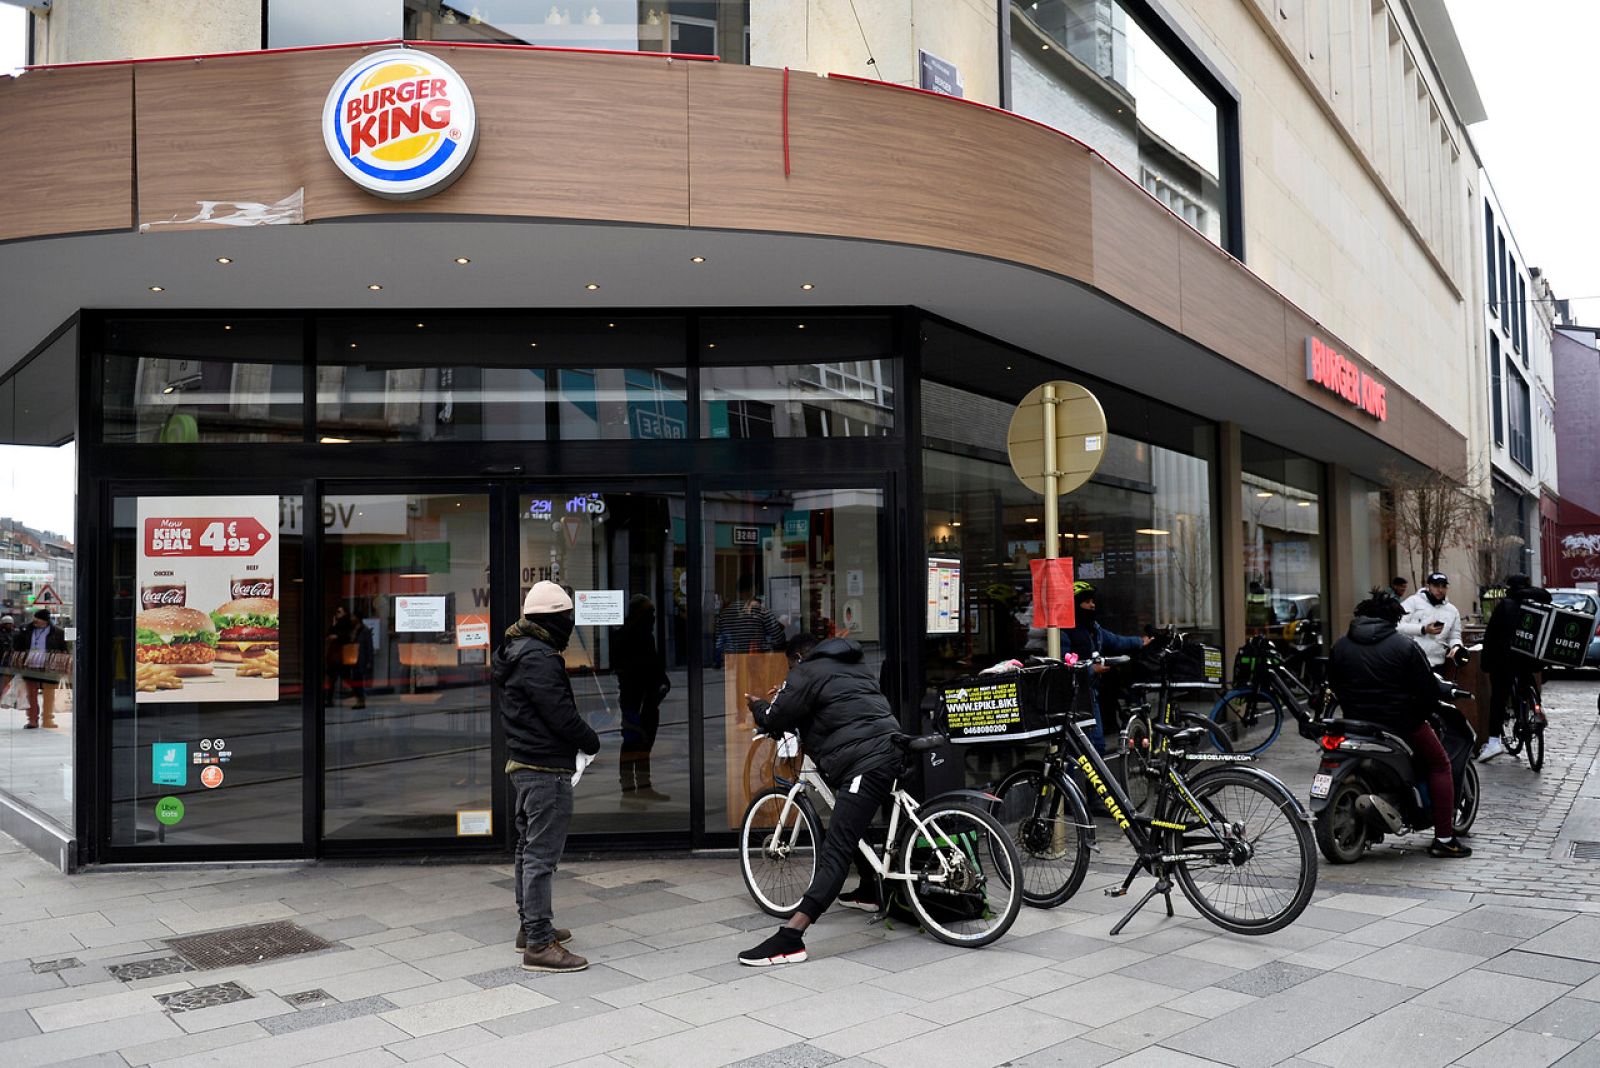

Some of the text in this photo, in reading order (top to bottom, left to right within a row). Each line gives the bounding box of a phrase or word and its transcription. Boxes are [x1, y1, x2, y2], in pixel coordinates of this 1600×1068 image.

[347, 78, 447, 124] BURGER
[351, 98, 451, 156] KING
[1309, 336, 1387, 421] BURGER KING
[160, 519, 182, 528] Menu
[152, 539, 192, 550] DEAL
[200, 522, 226, 552] 4
[227, 537, 251, 552] 95
[1555, 638, 1580, 649] UBER
[946, 698, 1018, 713] WWW.EPIKE.BIKE
[161, 803, 178, 811] Uber
